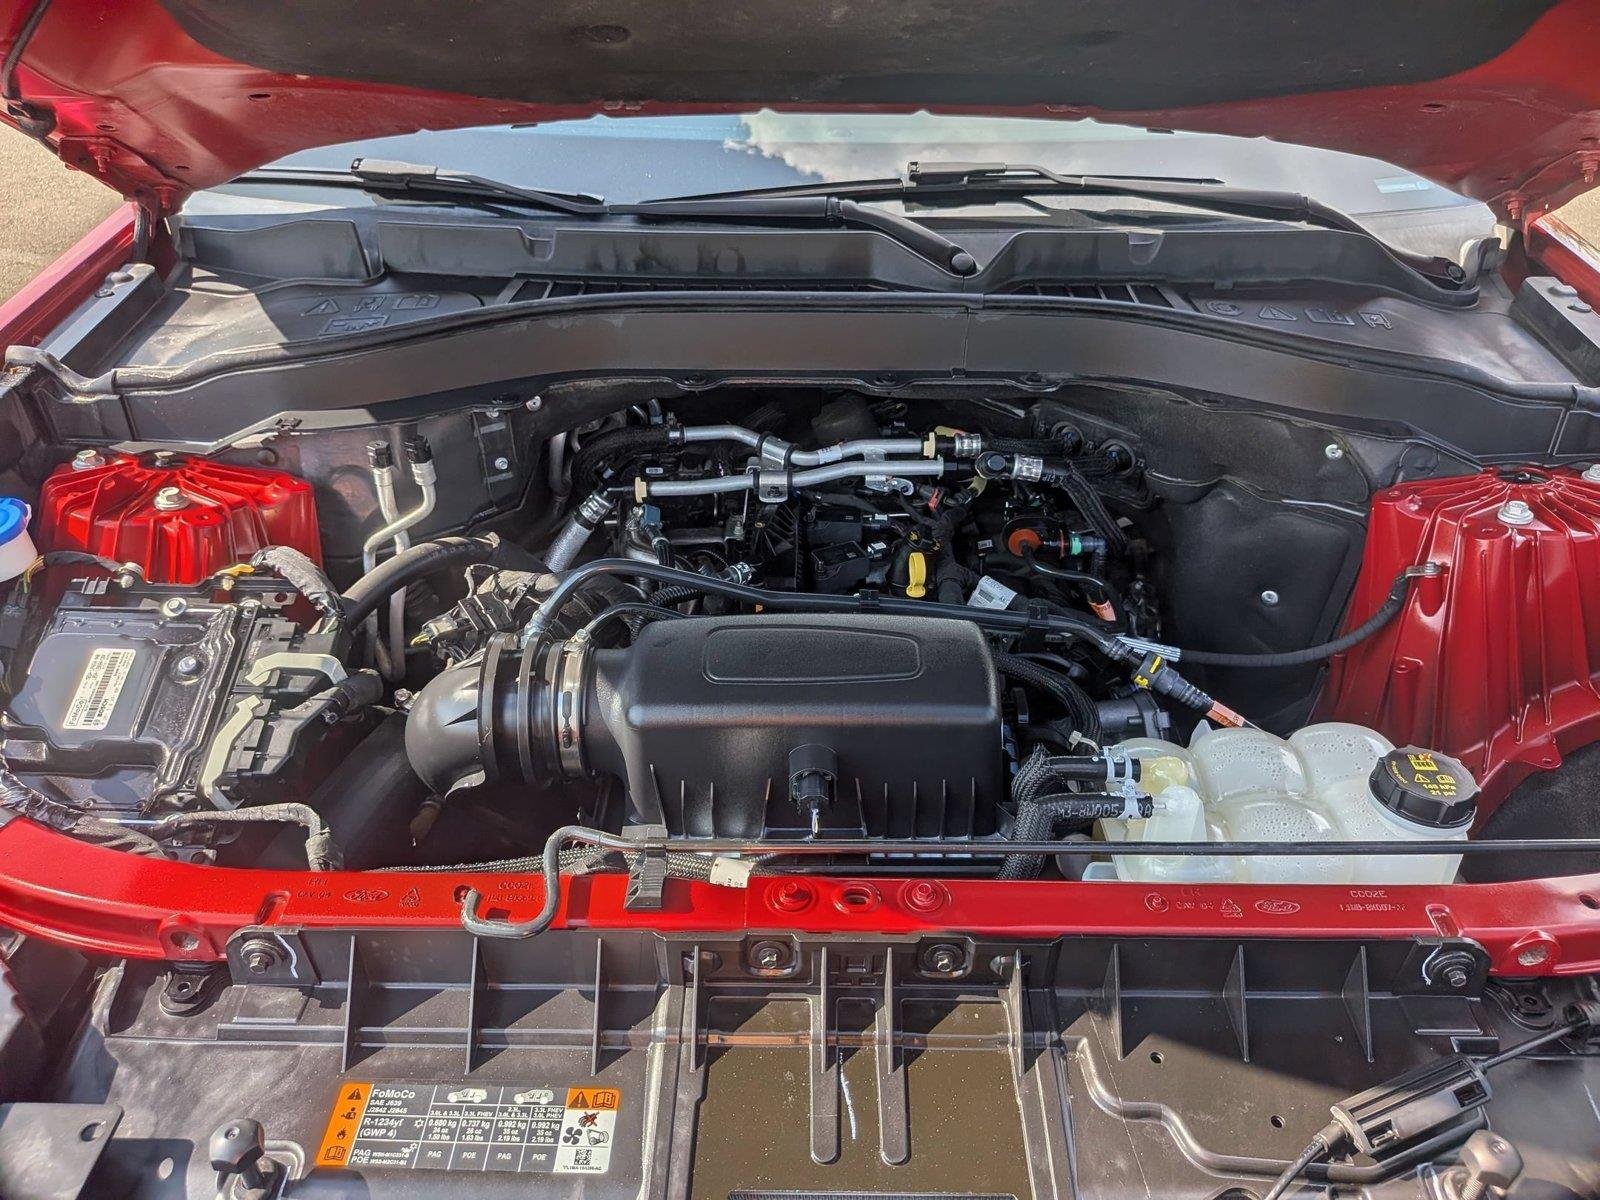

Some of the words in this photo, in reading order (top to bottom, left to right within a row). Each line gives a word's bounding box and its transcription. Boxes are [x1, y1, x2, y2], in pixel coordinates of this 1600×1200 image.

[372, 1089, 416, 1099] FoMoCo
[363, 1118, 404, 1127] R-1234yf
[447, 1119, 457, 1128] kg
[480, 1120, 490, 1129] kg
[517, 1121, 527, 1130] kg
[551, 1122, 560, 1131] kg
[360, 1129, 386, 1138] (GWP
[387, 1129, 397, 1138] 4)
[351, 1156, 369, 1164] POE
[497, 1152, 512, 1160] PAG
[532, 1153, 547, 1161] POE
